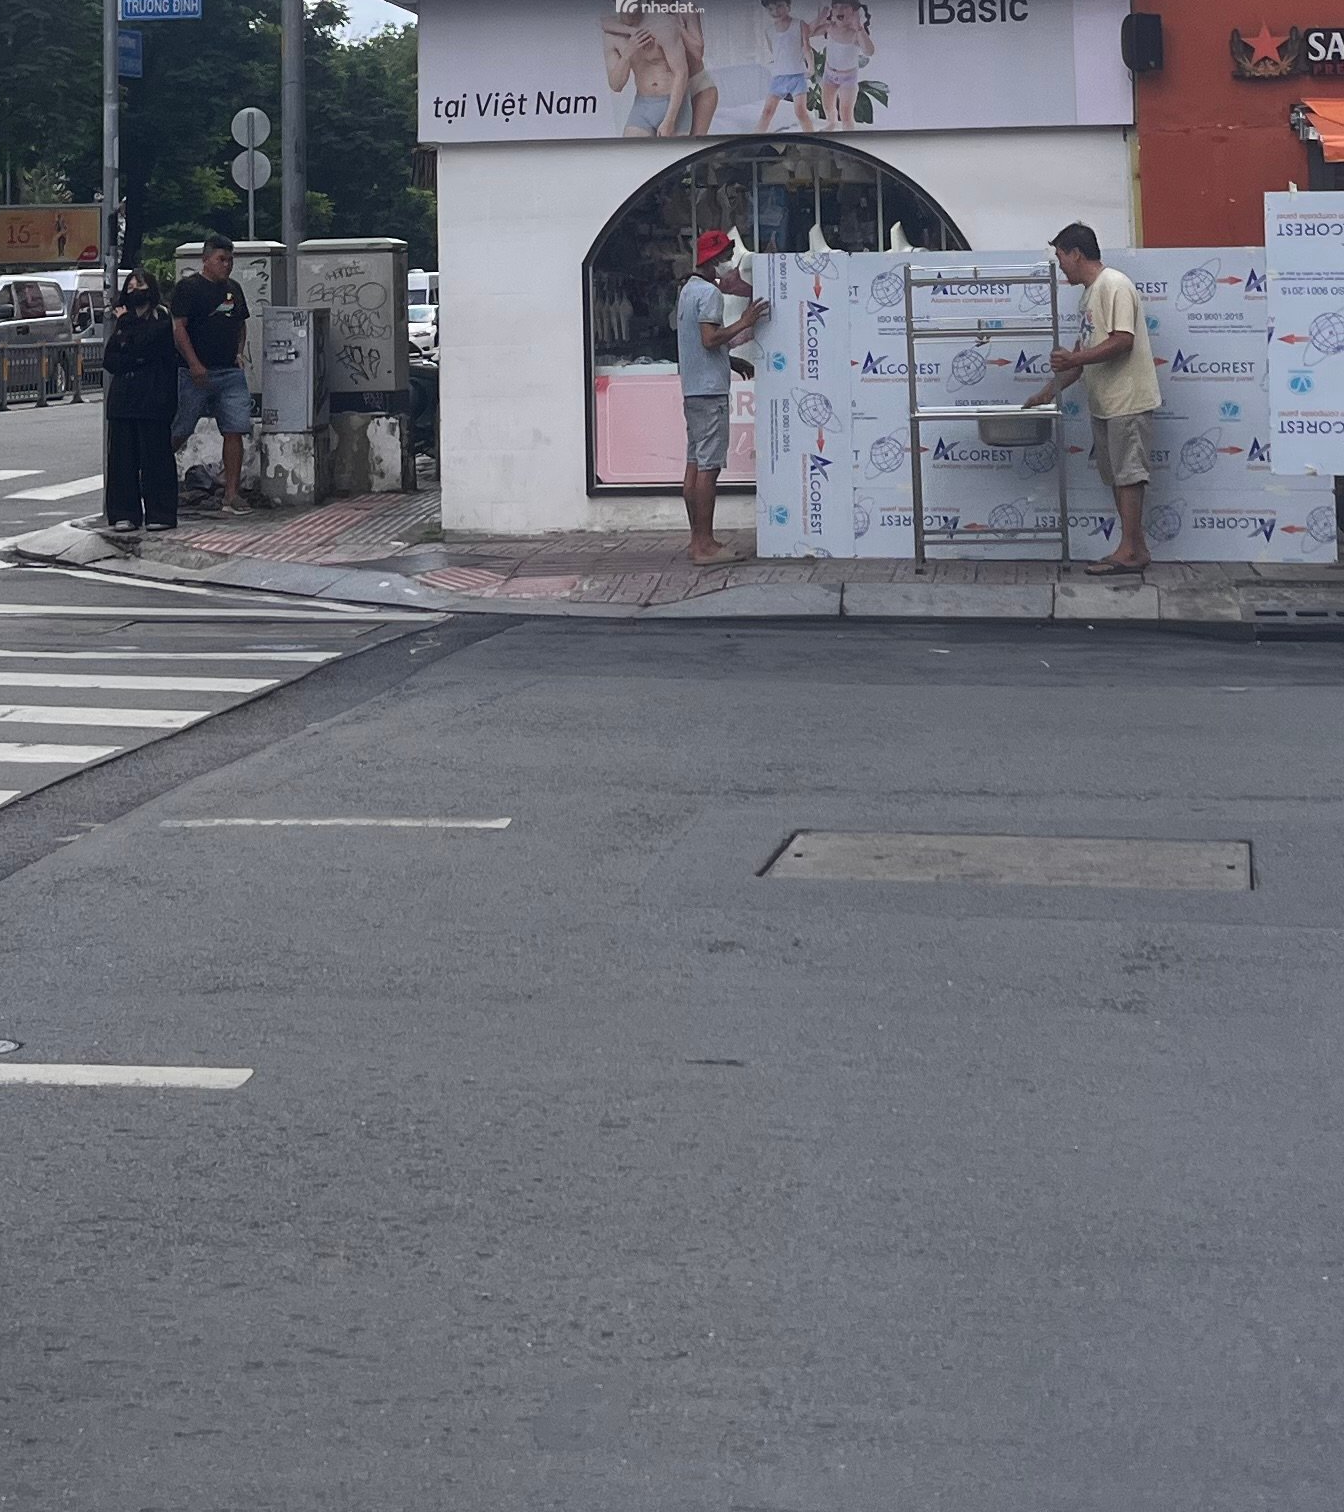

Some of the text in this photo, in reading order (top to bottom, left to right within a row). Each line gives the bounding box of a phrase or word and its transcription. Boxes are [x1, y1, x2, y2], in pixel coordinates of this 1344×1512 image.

[433, 91, 597, 124] tại Việt Nam
[1136, 282, 1167, 293] REST
[807, 300, 830, 380] ALCOREST
[861, 350, 940, 374] ALCOEST
[1171, 348, 1255, 373] ALCOREST
[933, 437, 1013, 461] ALCOREST
[809, 453, 833, 535] ALCOREST
[1193, 517, 1276, 542] ALCOREST
